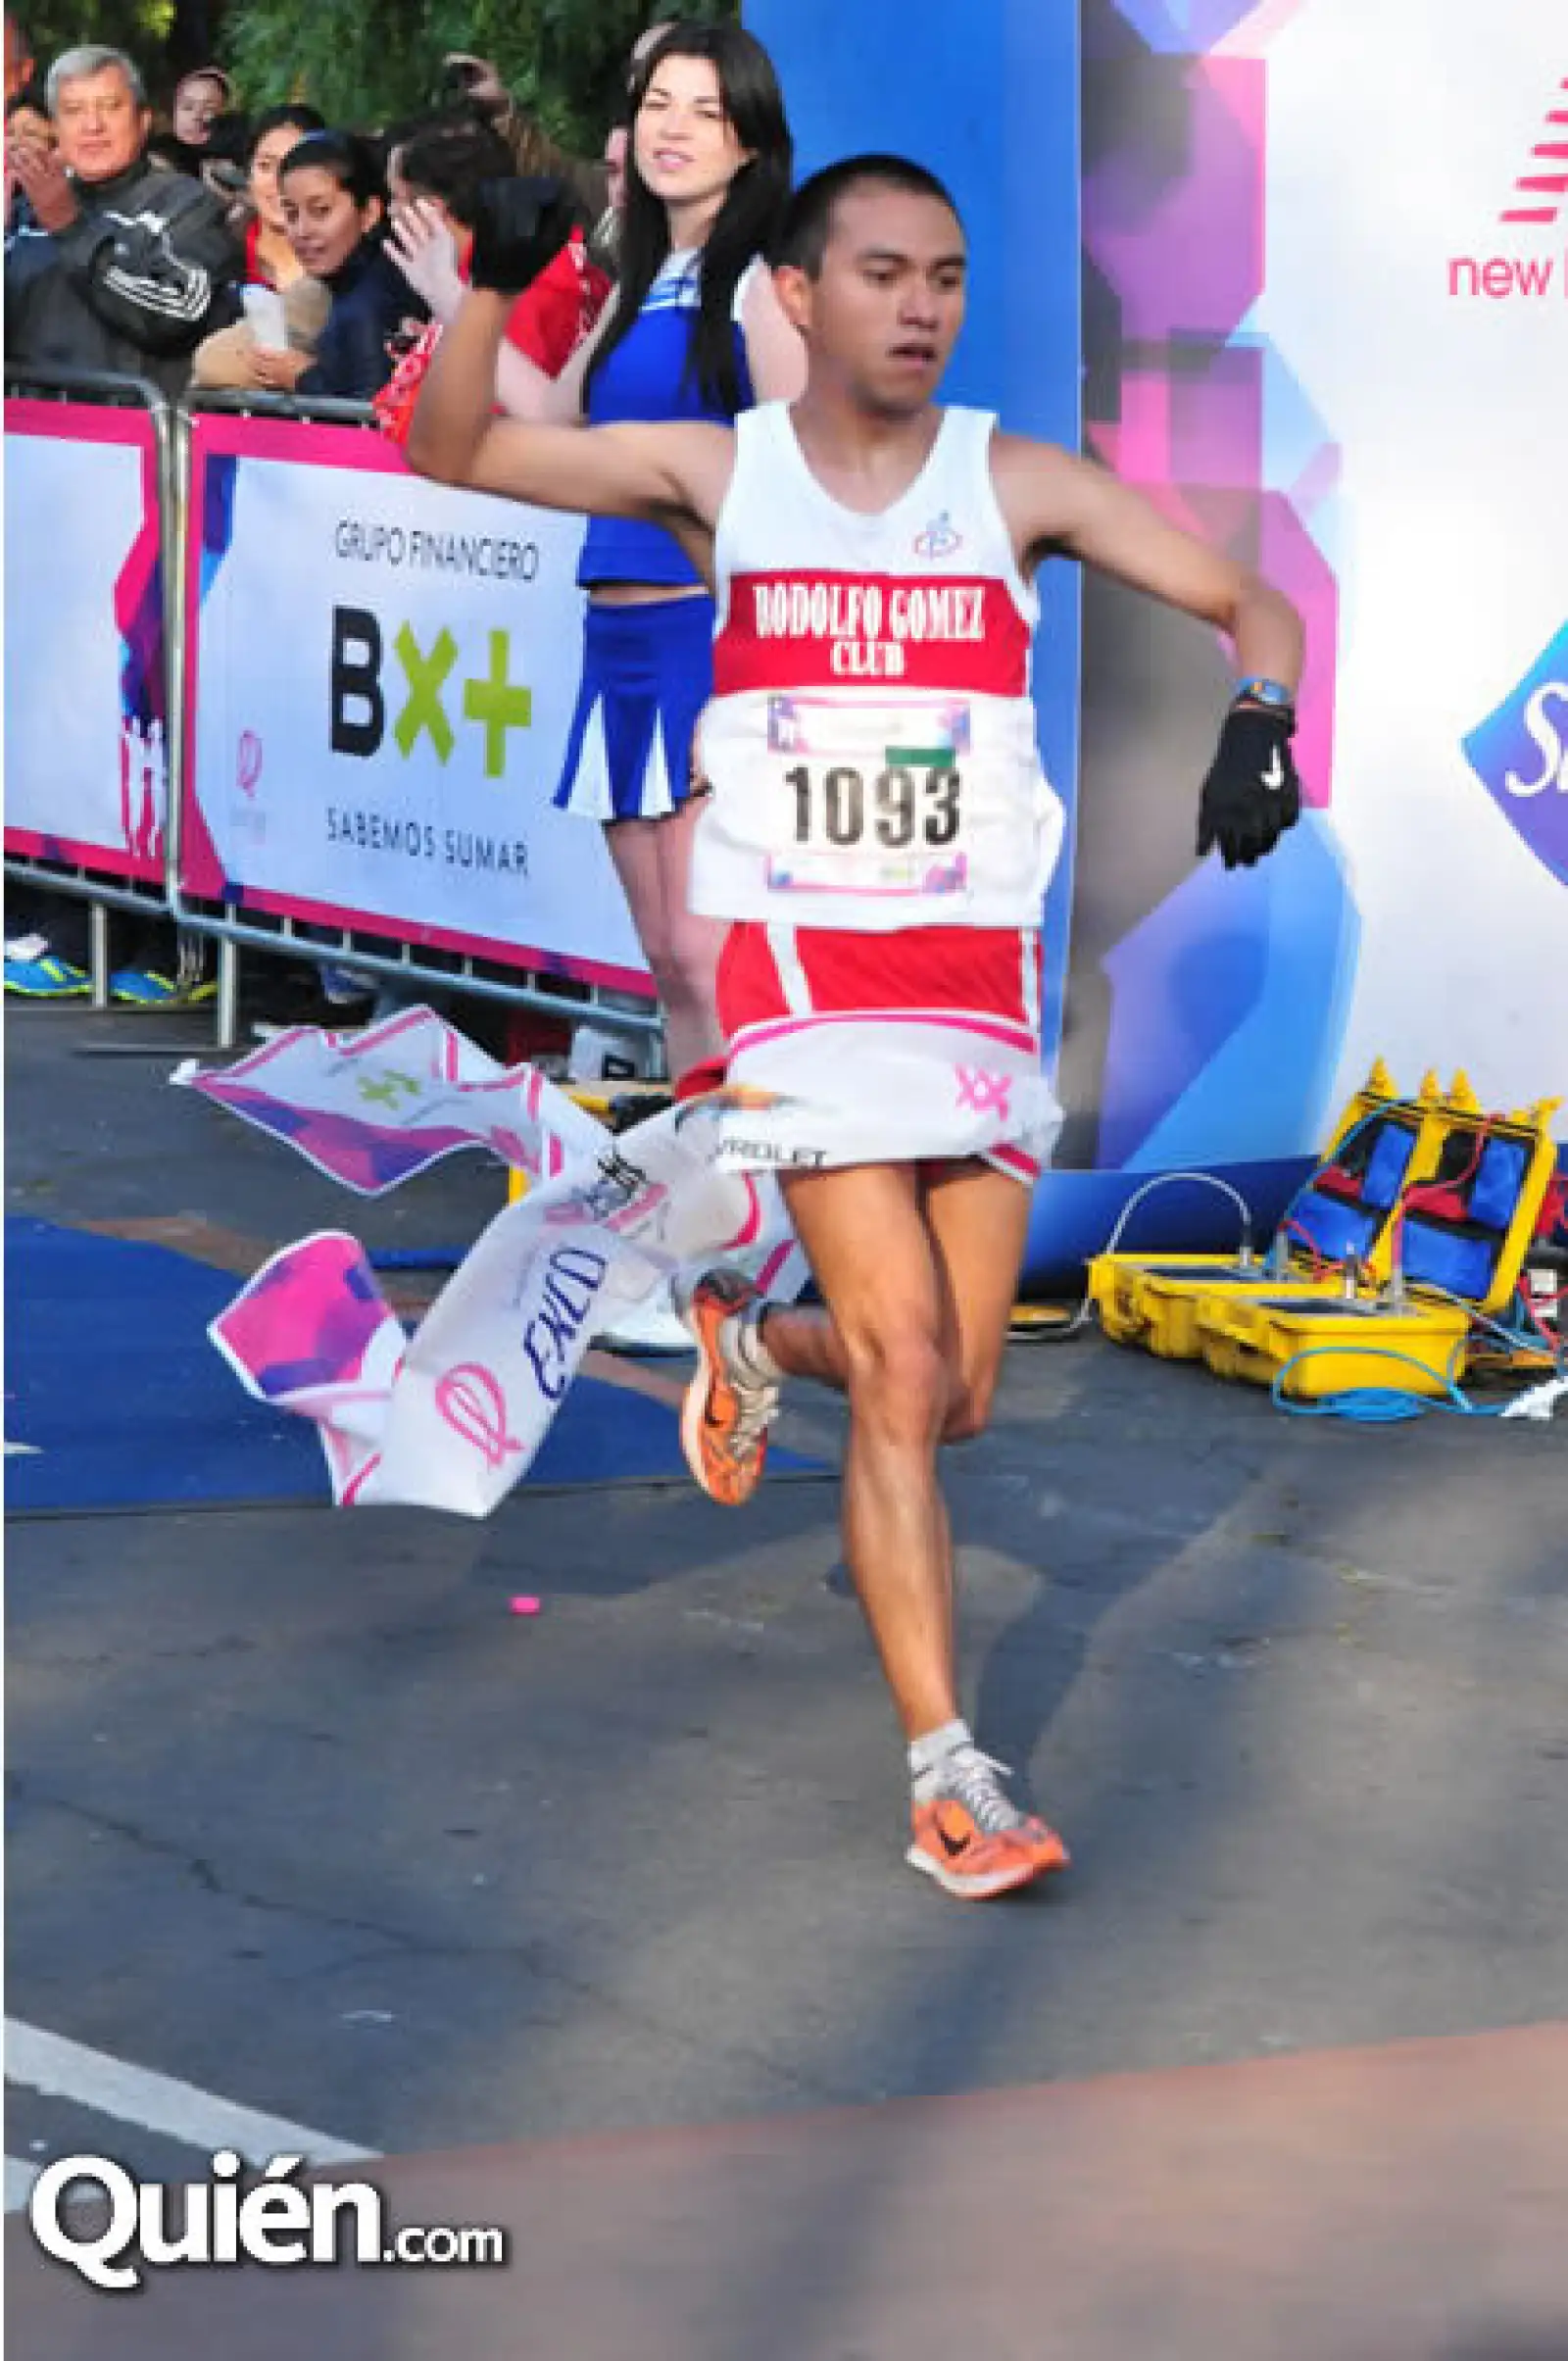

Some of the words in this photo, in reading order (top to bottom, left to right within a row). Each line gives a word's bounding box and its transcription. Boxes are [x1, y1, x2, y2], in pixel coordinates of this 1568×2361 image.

[1447, 255, 1555, 299] new
[335, 519, 406, 566] GRUPO
[410, 529, 540, 582] FINANCIERO
[753, 582, 882, 639] RODOLFO
[889, 585, 985, 642] GOMEZ
[829, 639, 906, 677] CLUB
[1504, 681, 1568, 798] S
[786, 764, 961, 849] 1093
[326, 807, 436, 859] SABEMOS
[445, 828, 529, 876] SUMAR
